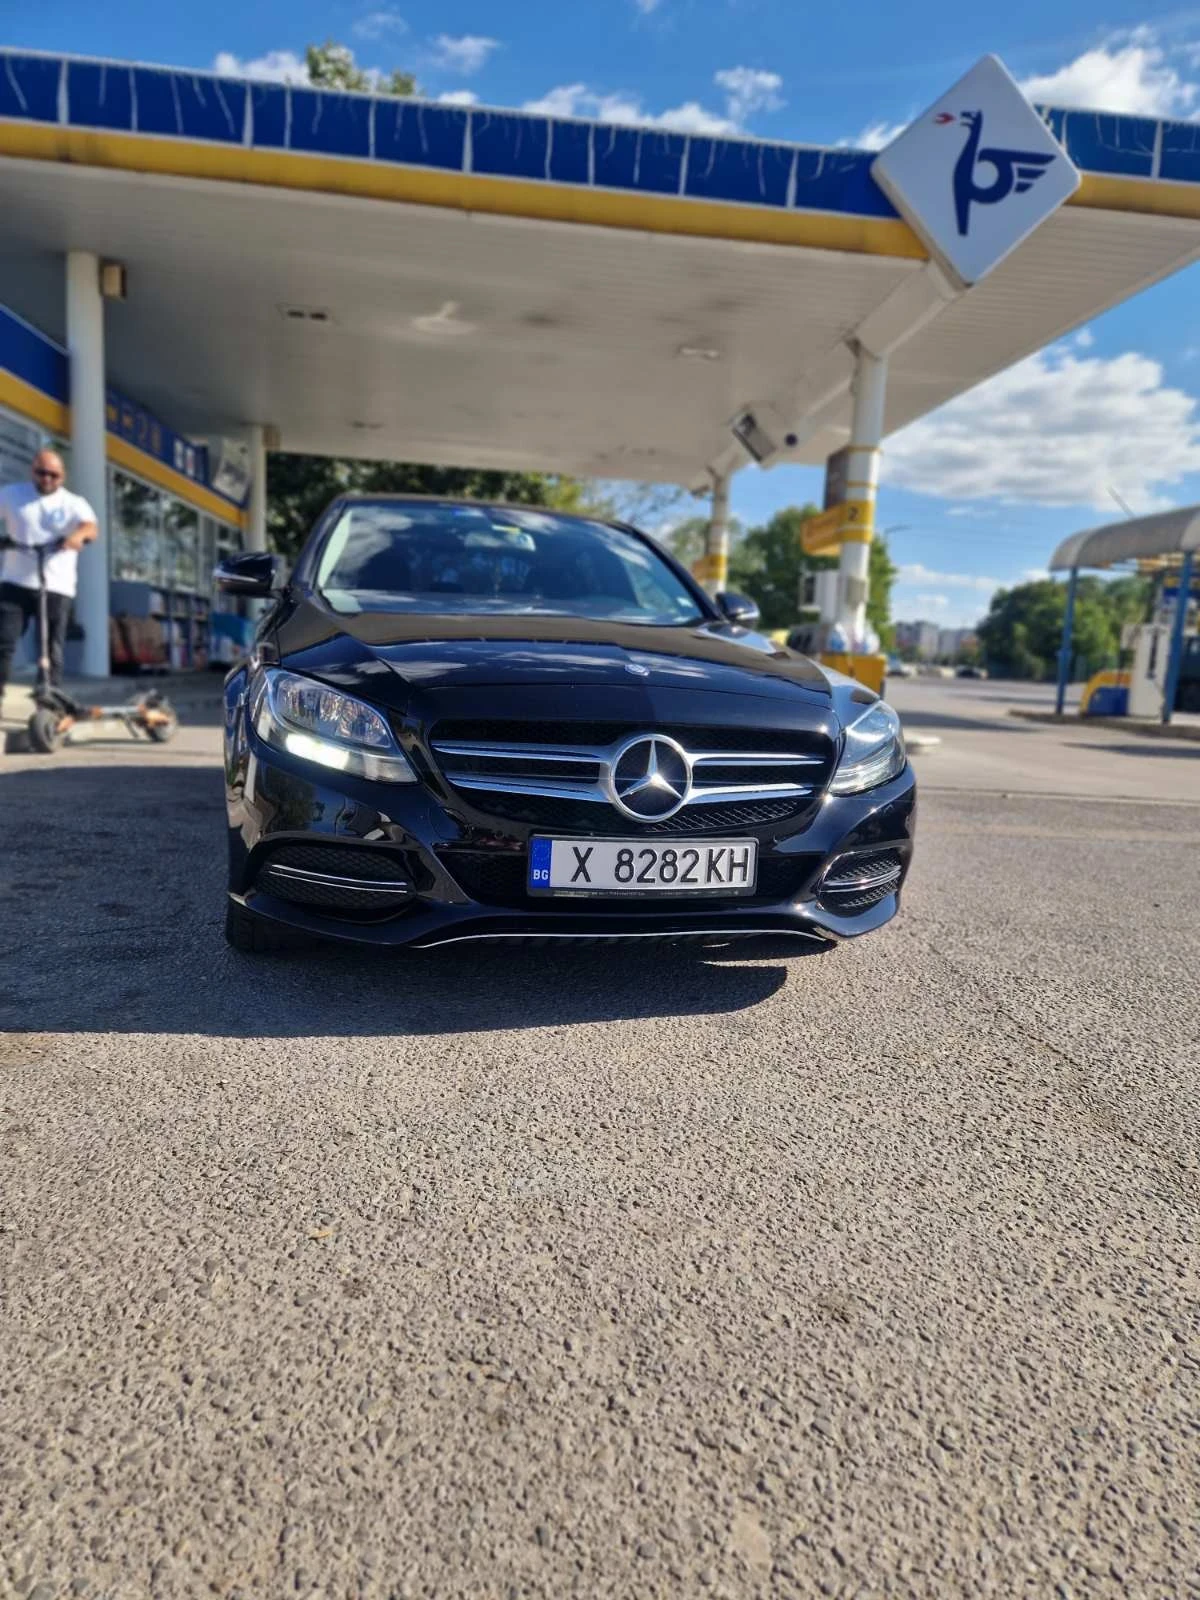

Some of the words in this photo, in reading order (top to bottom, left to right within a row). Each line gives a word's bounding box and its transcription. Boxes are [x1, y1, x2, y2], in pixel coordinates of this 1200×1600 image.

[848, 506, 858, 521] 2
[570, 846, 594, 883] X
[533, 869, 549, 881] BG
